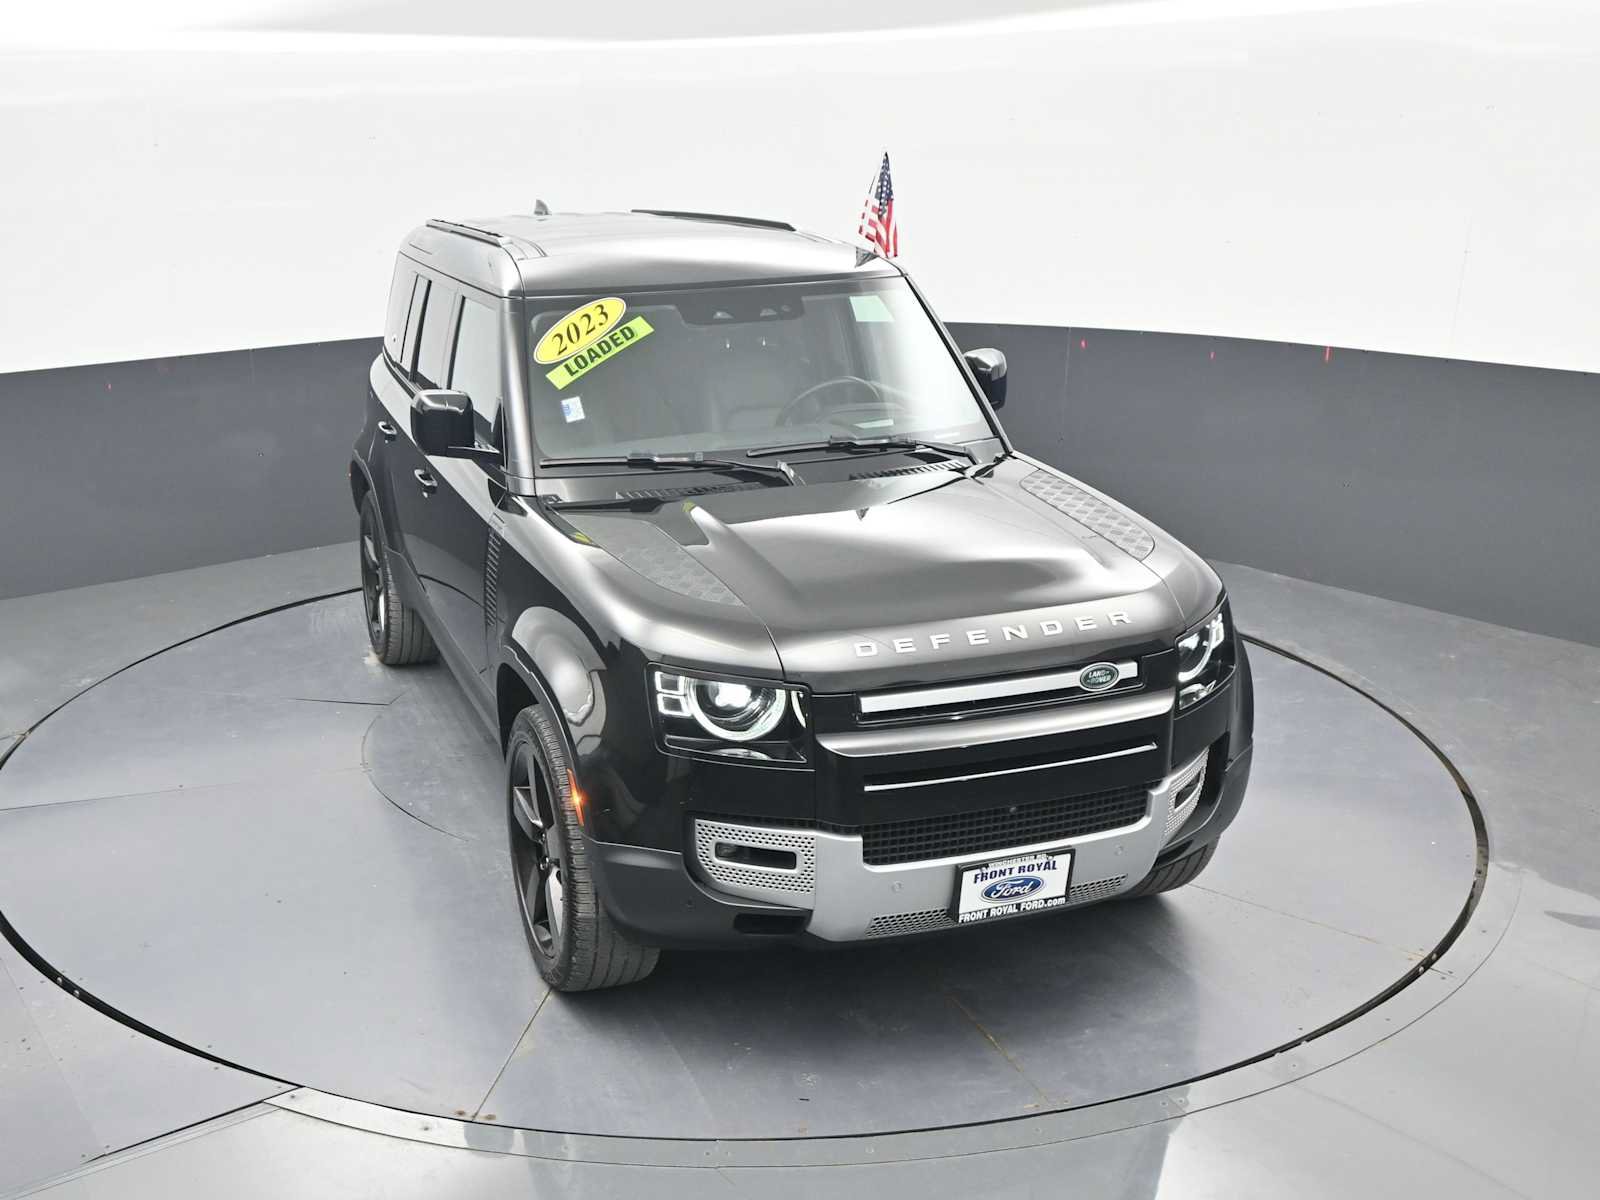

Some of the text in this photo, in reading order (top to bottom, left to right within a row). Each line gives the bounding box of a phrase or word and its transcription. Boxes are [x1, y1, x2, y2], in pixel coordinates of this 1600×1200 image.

[552, 304, 609, 356] 2023
[564, 325, 635, 377] LOADED
[854, 610, 1132, 658] DEFENDER
[974, 860, 1057, 884] FRONT ROYAL
[990, 879, 1035, 898] Ford
[958, 897, 1066, 923] FRONT ROYAL FORD.com
